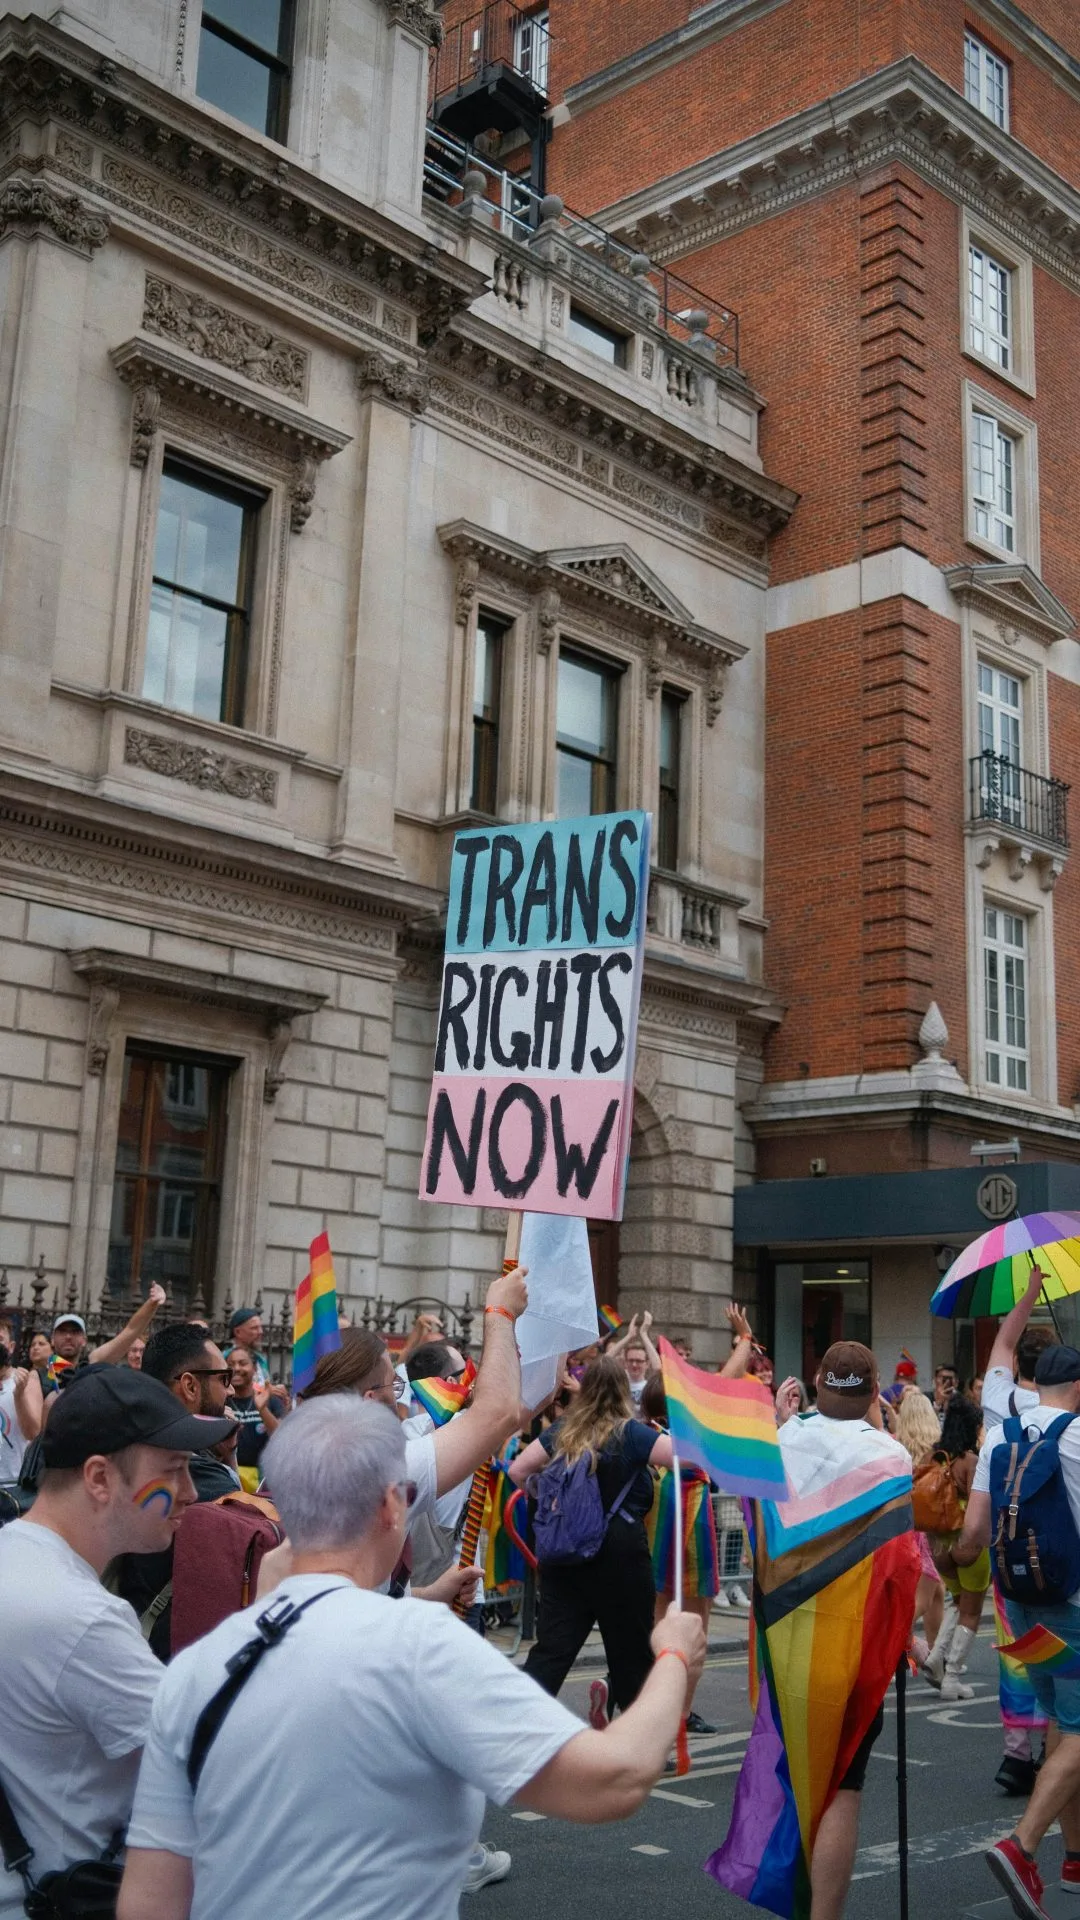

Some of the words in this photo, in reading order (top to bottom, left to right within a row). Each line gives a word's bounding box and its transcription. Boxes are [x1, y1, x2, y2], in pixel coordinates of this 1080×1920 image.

[455, 819, 639, 949] TRANS
[434, 952, 633, 1074] RIGHTS
[426, 1082, 620, 1200] NOW
[980, 1178, 1013, 1215] MG
